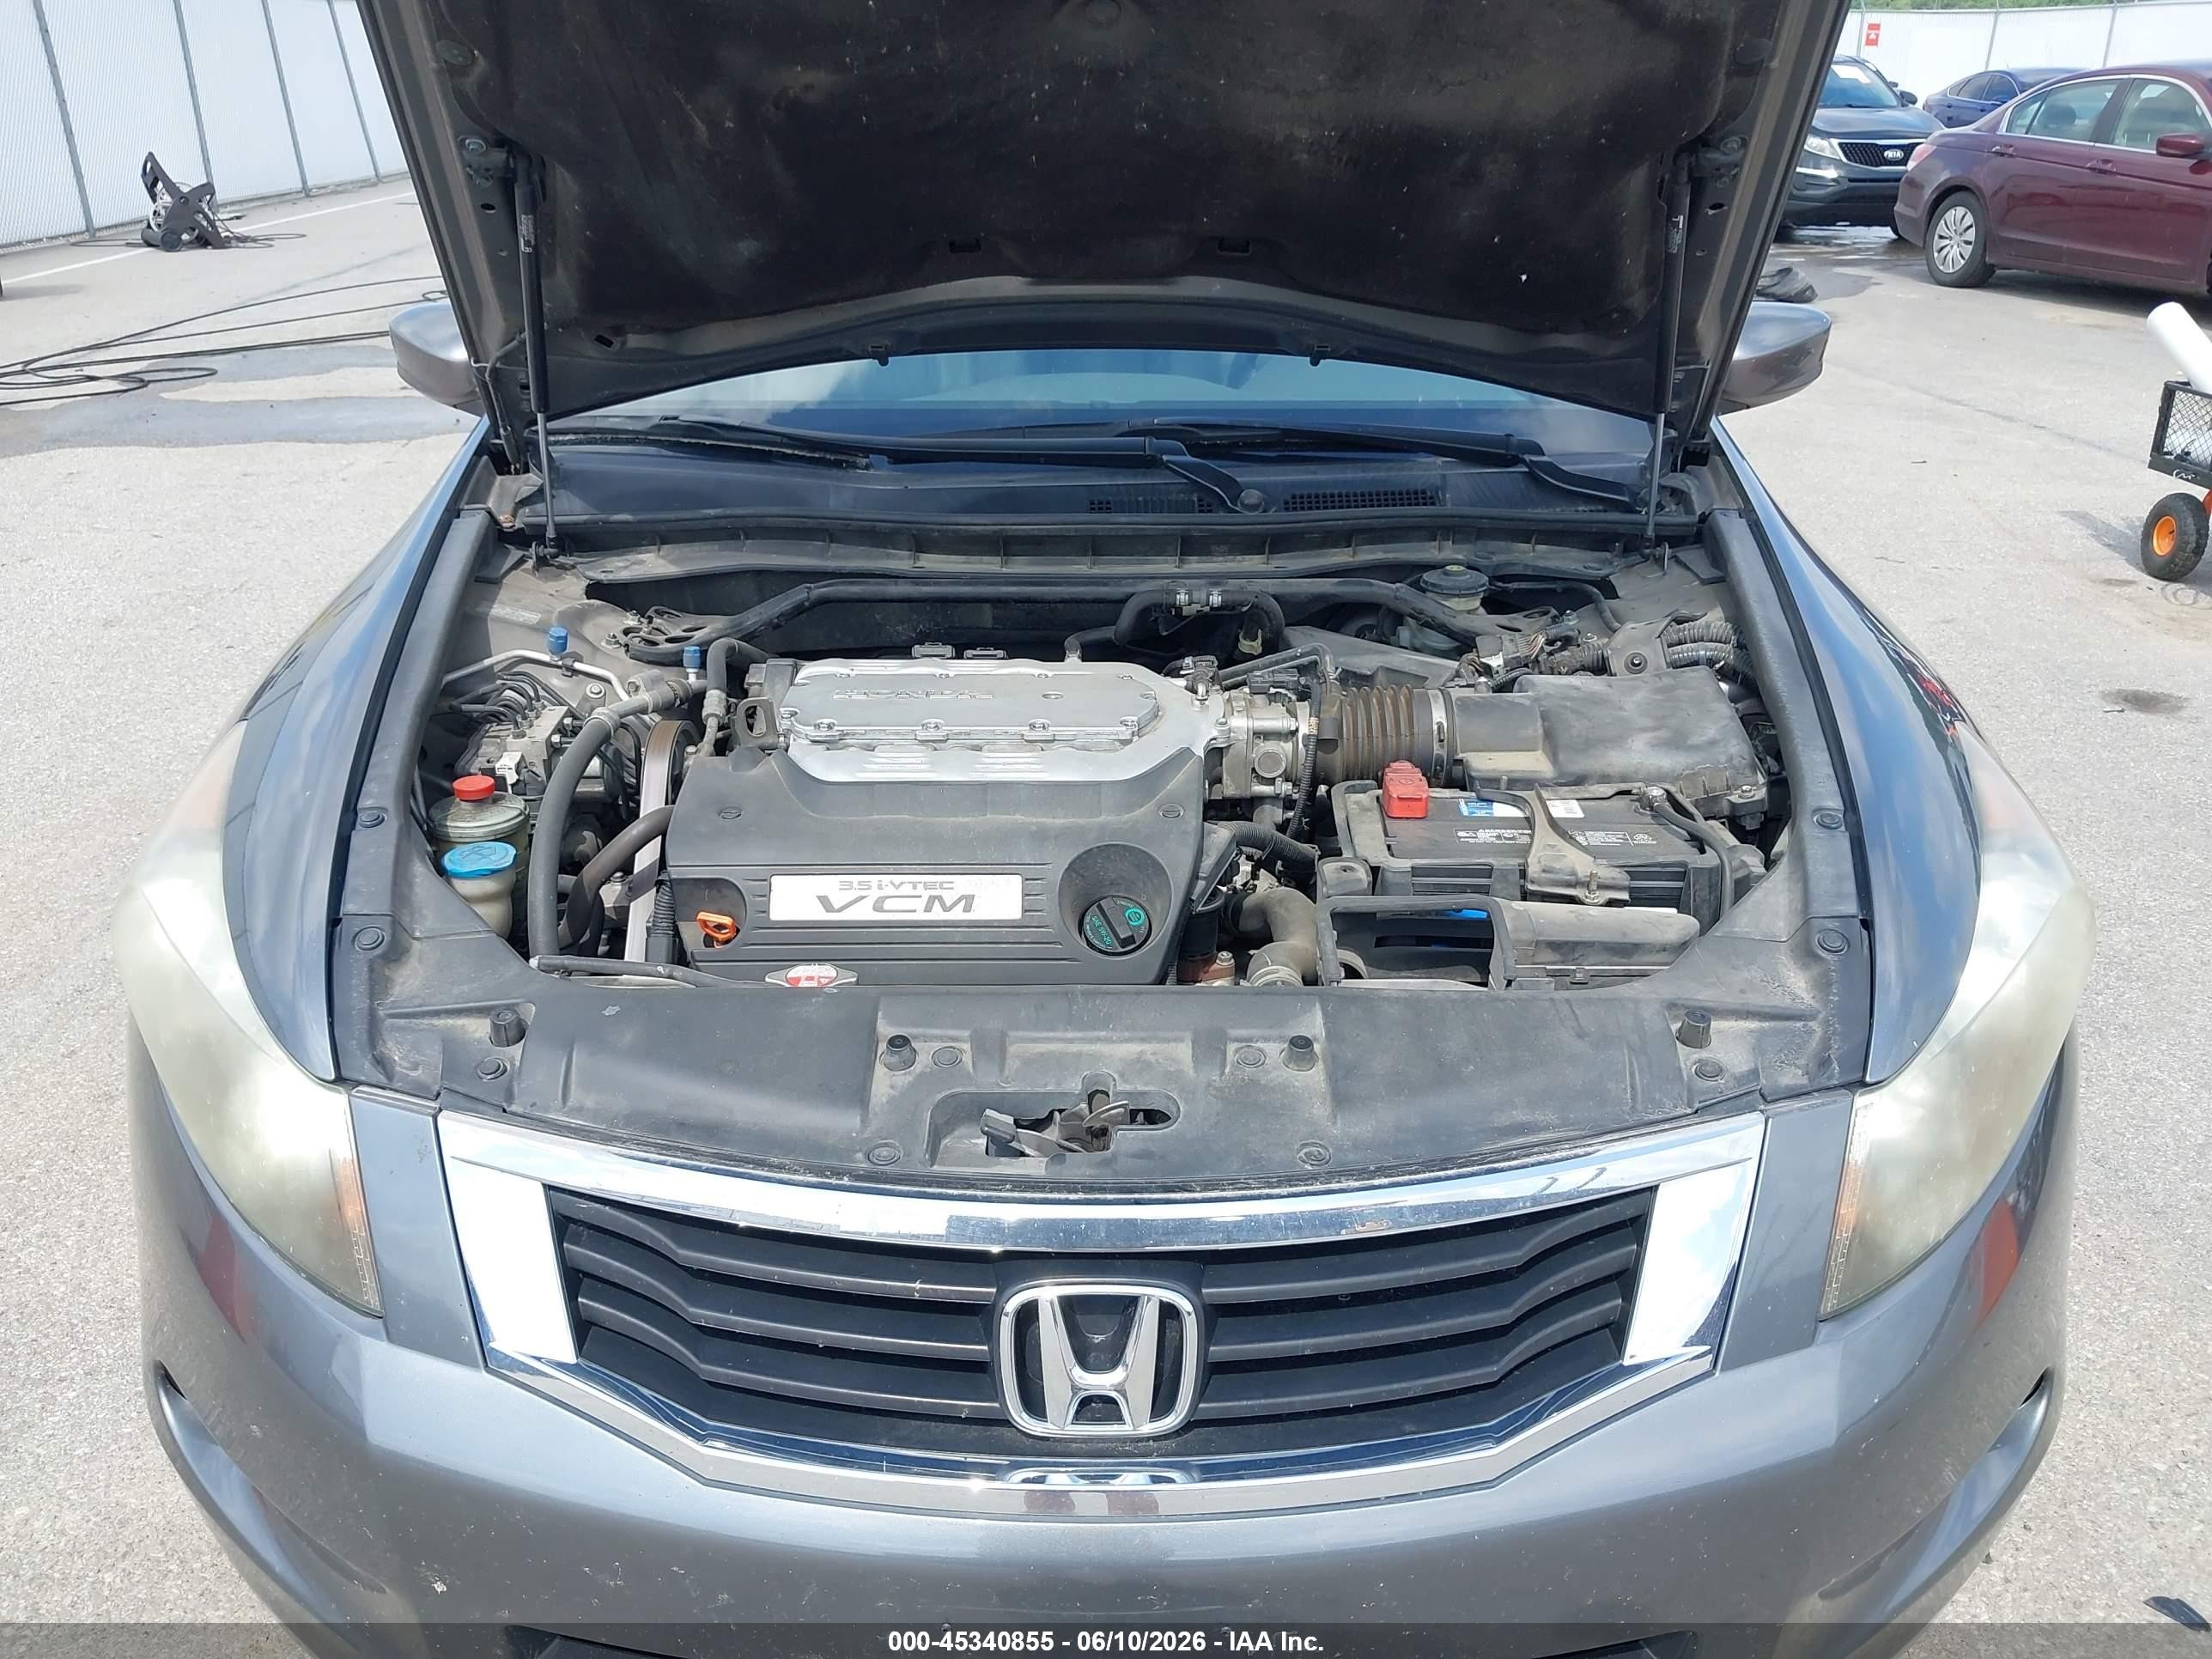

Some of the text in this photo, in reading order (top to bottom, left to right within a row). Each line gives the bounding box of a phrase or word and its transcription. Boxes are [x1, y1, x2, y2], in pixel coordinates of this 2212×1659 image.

[838, 879, 955, 891] 3.5 i-VTEC
[816, 894, 976, 914] VCM
